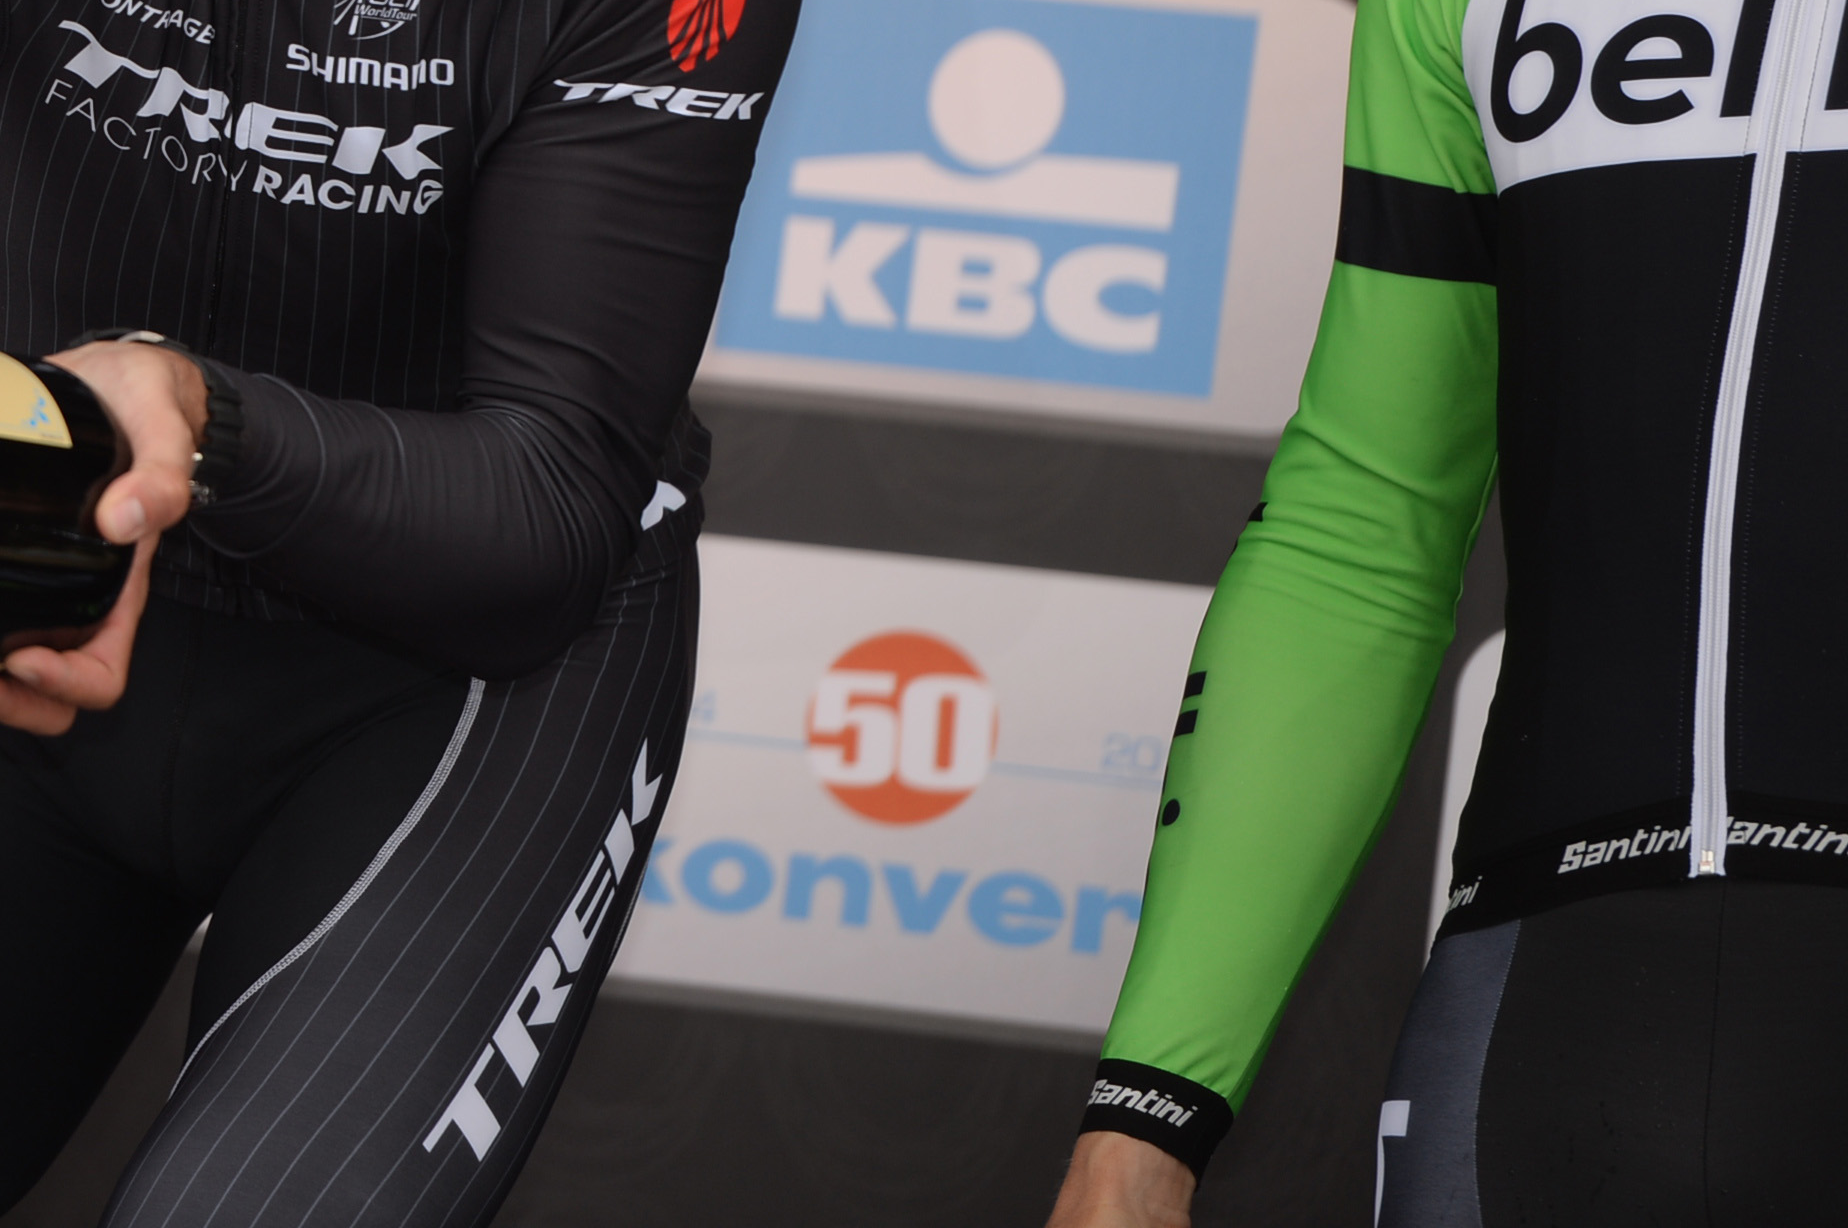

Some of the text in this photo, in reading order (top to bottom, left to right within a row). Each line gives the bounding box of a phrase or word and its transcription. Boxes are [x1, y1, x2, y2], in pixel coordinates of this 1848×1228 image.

[355, 3, 417, 22] WorldTour
[45, 78, 444, 216] FACTORY RACING
[59, 20, 455, 181] TREK
[553, 79, 765, 121] TREK
[773, 213, 1170, 354] KBC
[809, 670, 994, 792] 50
[422, 737, 663, 1162] TREK
